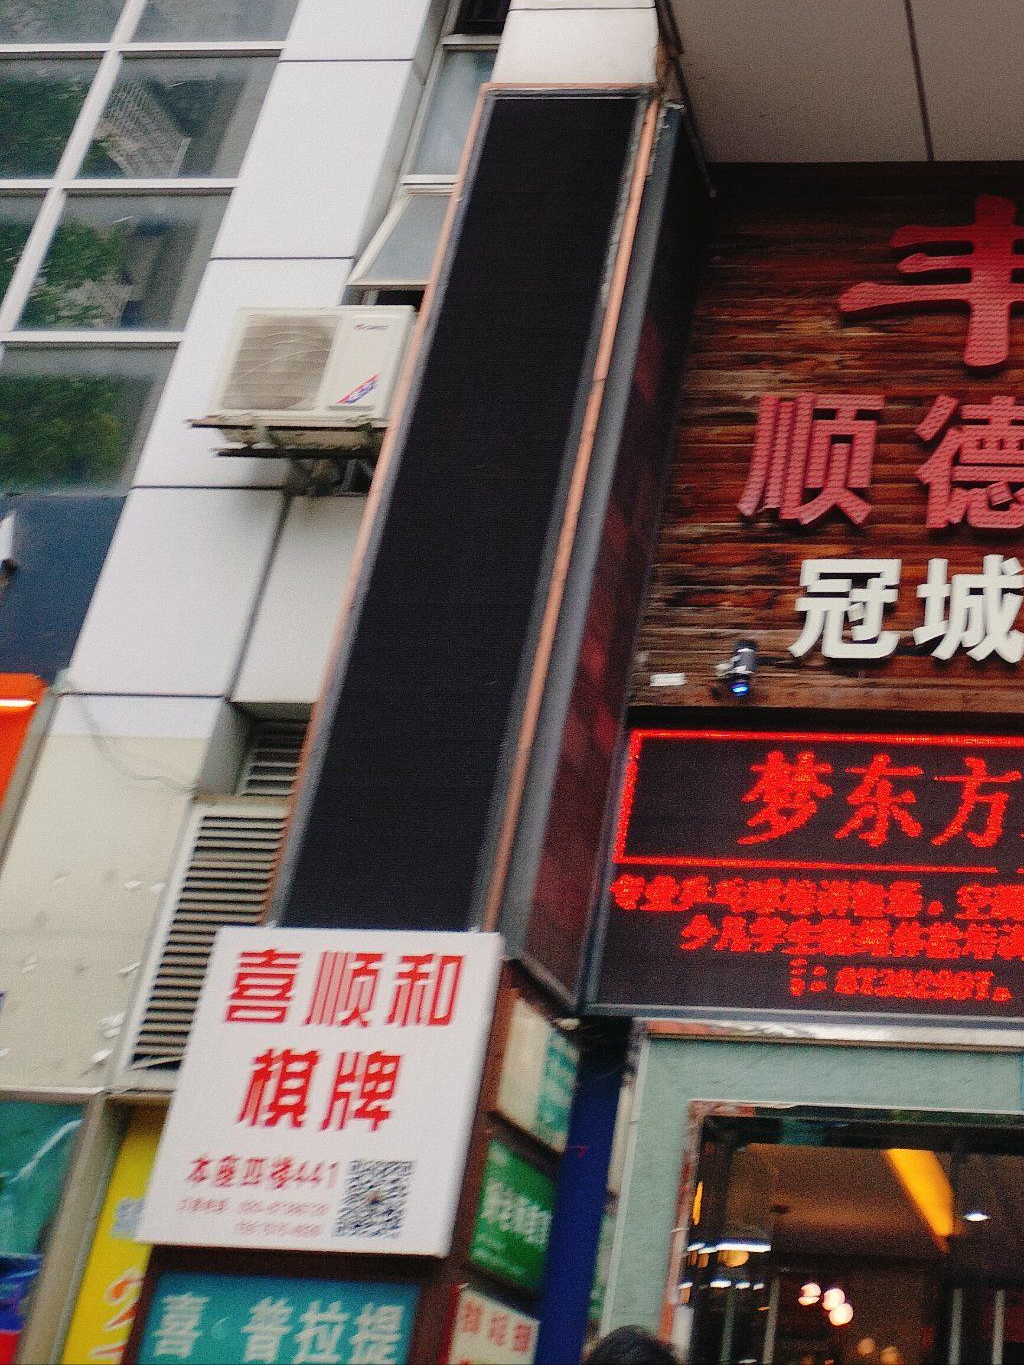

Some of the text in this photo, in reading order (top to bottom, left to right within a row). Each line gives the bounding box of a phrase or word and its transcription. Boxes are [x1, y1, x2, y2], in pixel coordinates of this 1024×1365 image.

[223, 949, 467, 1027] 喜顺和
[236, 1048, 404, 1132] 棋牌
